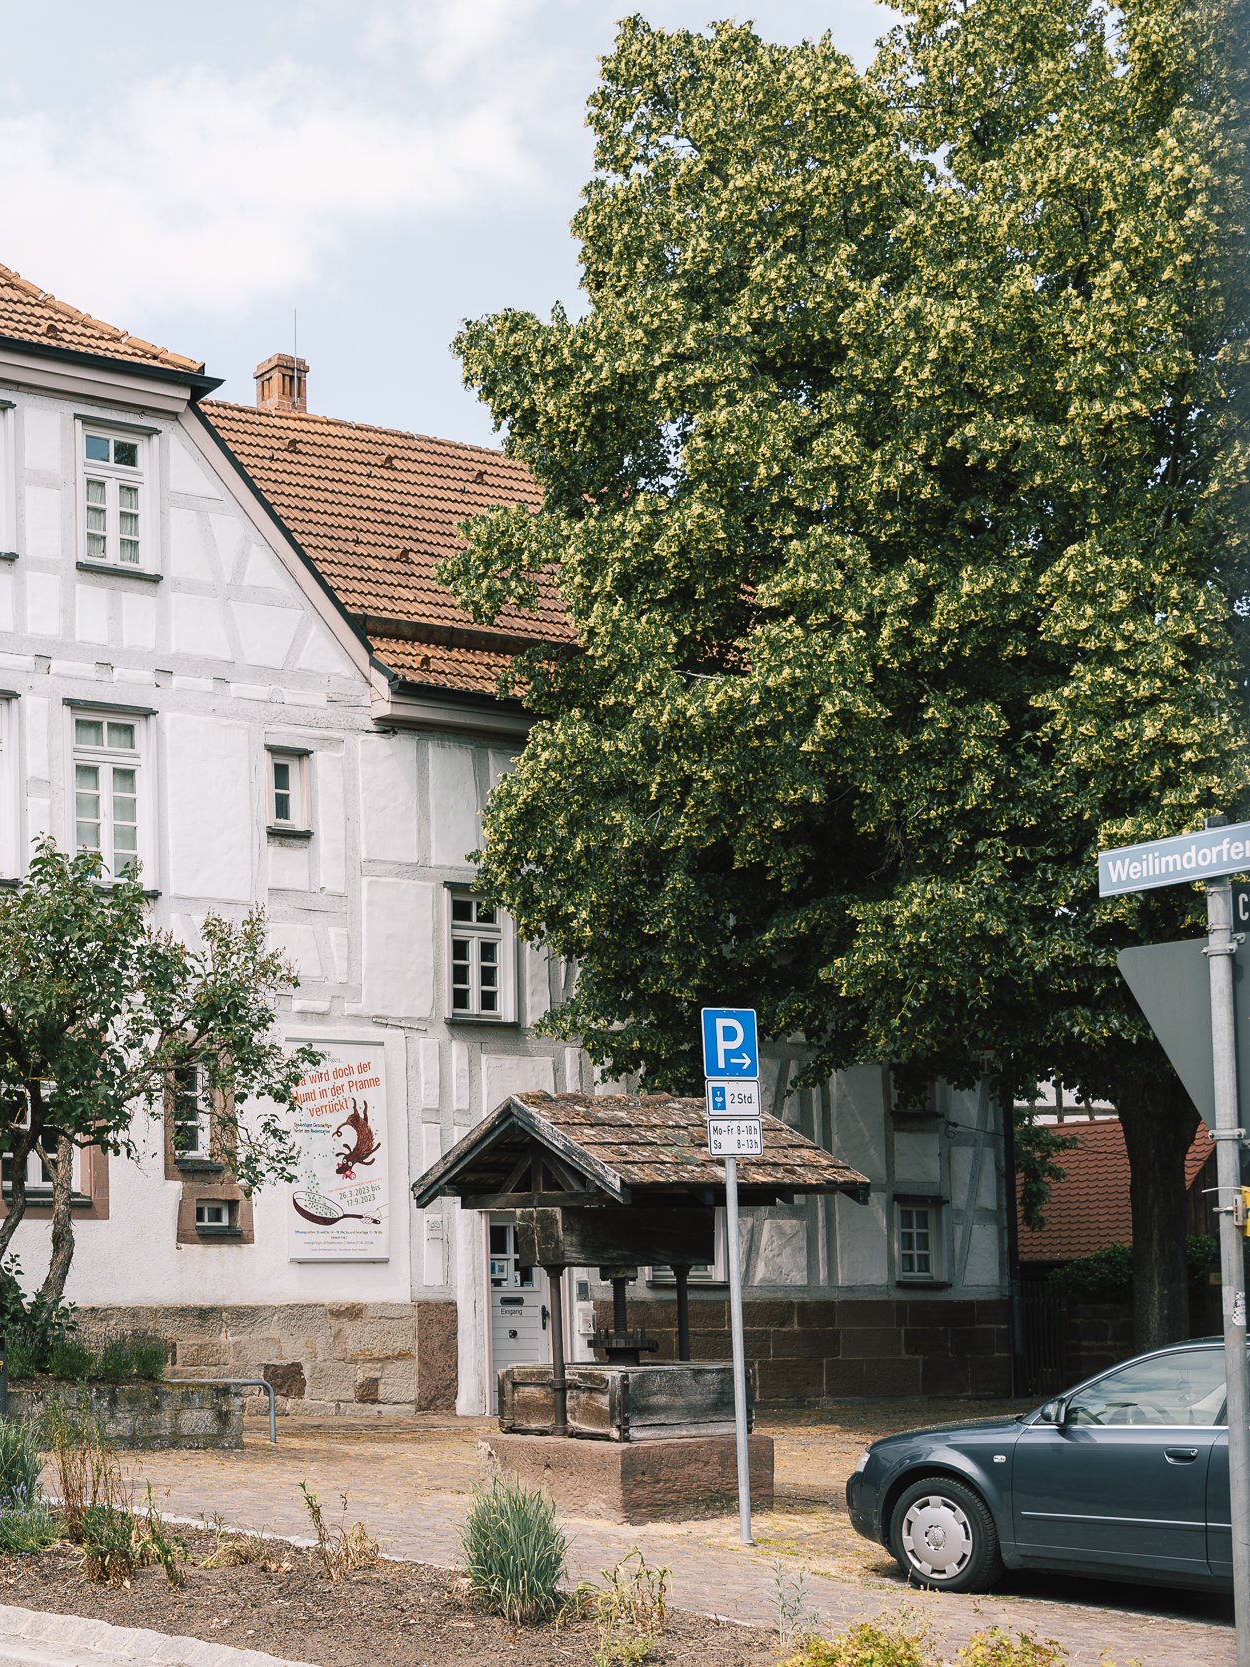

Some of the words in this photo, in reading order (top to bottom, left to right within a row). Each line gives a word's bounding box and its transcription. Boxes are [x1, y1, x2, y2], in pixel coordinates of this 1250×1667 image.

[1238, 892, 1250, 921] C
[715, 1018, 745, 1069] P
[308, 1069, 330, 1085] wird
[332, 1064, 355, 1080] doch
[357, 1061, 372, 1075] der
[318, 1086, 328, 1100] in
[330, 1083, 345, 1097] der
[348, 1076, 381, 1093] Pfanne
[729, 1093, 736, 1104] 2
[737, 1093, 755, 1104] Std.
[308, 1097, 349, 1118] verrückt
[713, 1139, 722, 1150] Sa
[370, 1183, 381, 1192] bis
[500, 1308, 523, 1316] Eingang
